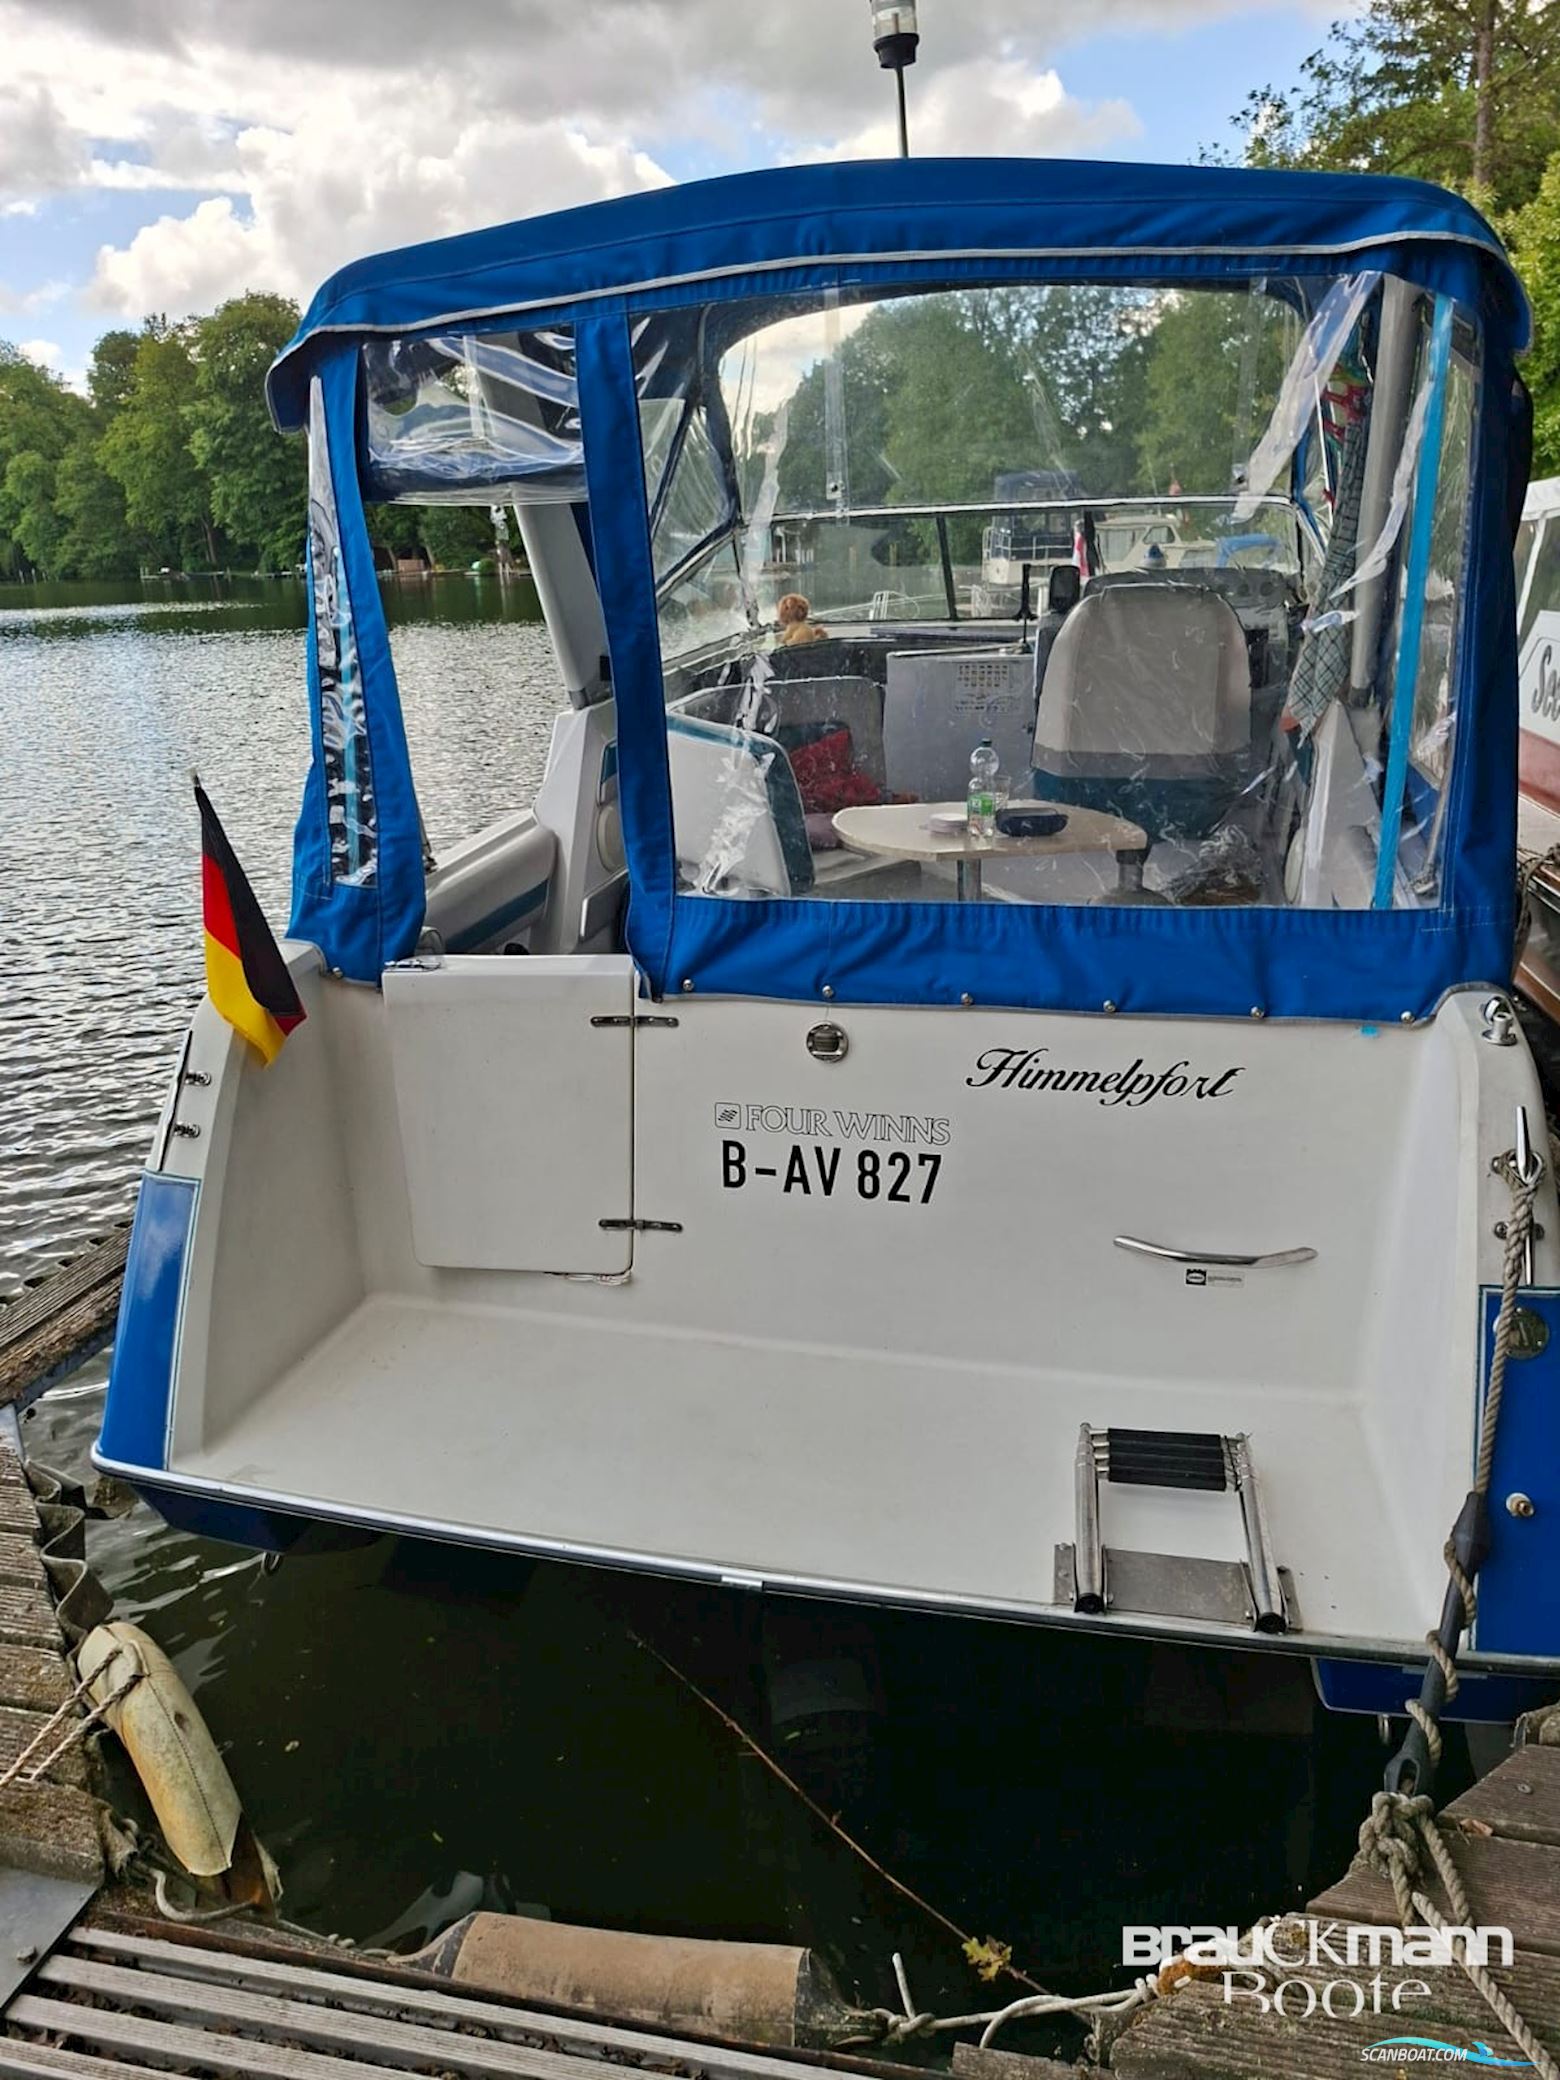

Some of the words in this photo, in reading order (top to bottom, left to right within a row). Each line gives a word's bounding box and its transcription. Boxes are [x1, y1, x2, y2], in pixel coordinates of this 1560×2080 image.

[966, 1047, 1246, 1107] Himmelpfort
[745, 1104, 832, 1138] FOUR
[834, 1112, 950, 1146] WINNS
[857, 1150, 943, 1205] 827
